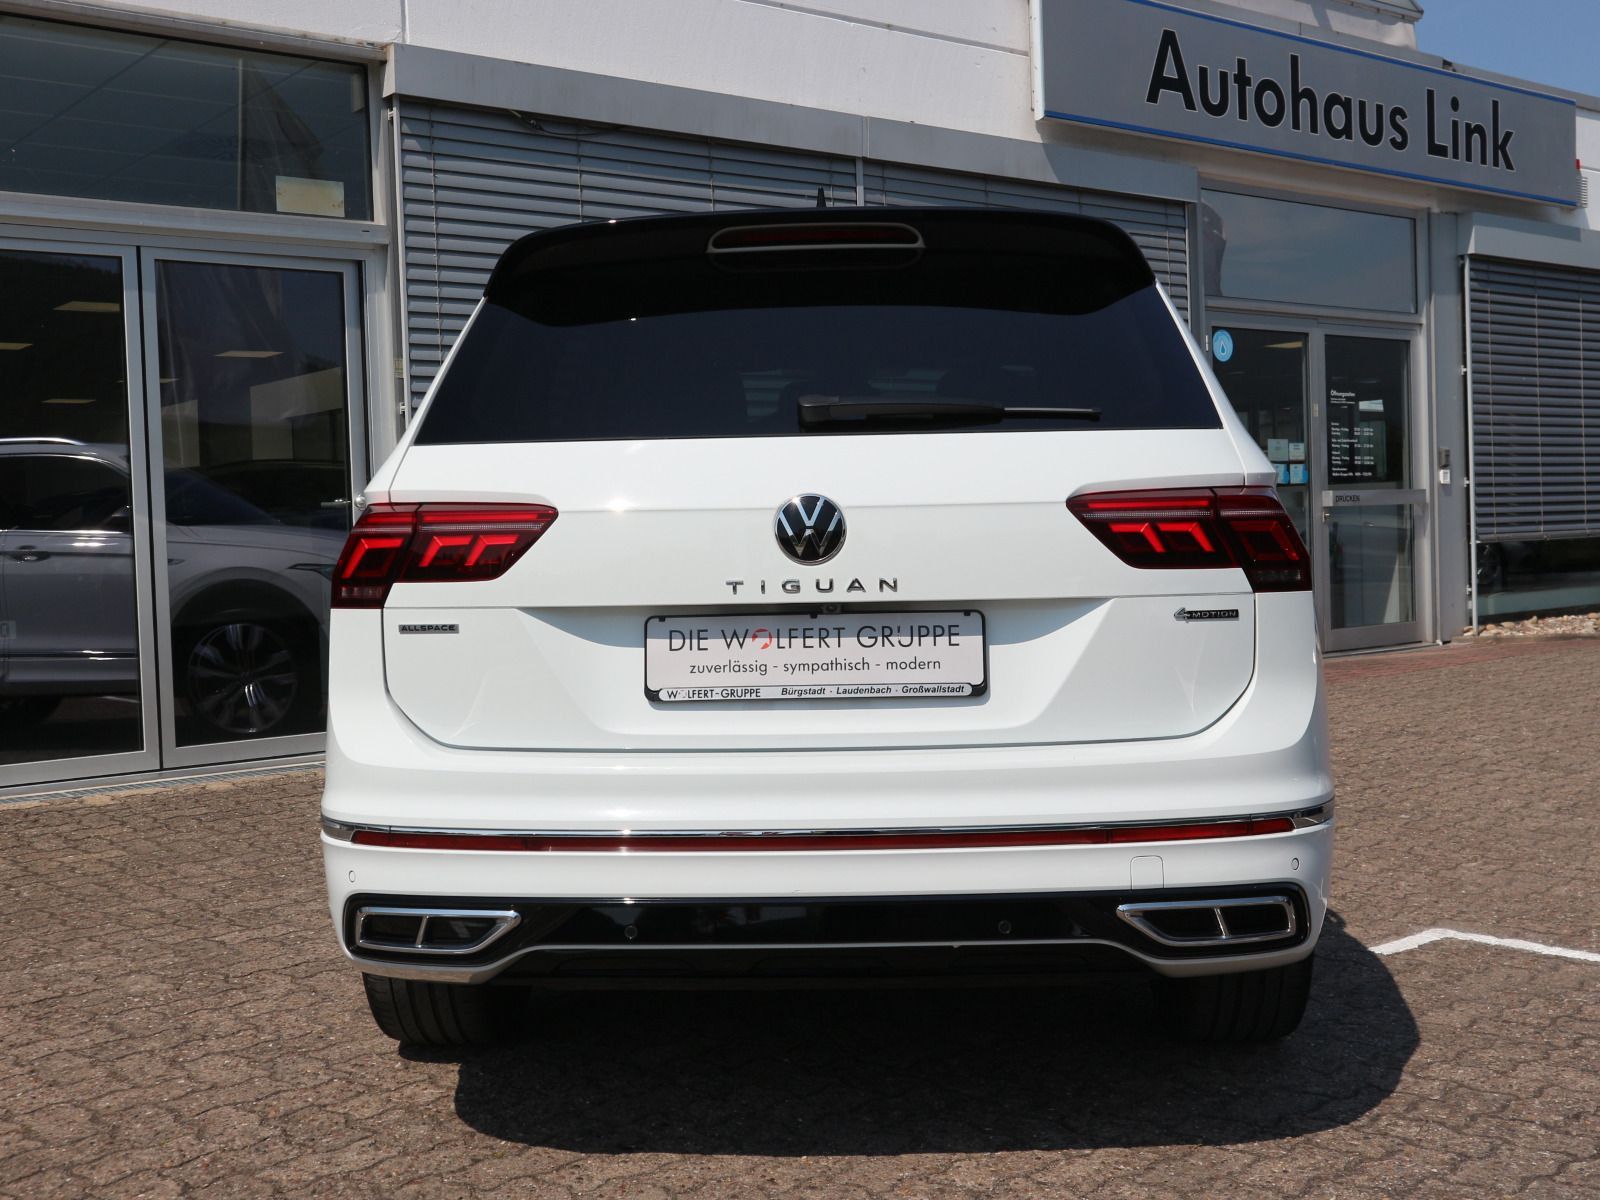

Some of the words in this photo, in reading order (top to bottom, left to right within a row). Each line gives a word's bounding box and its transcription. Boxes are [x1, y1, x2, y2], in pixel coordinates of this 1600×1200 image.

[1145, 28, 1409, 152] Autohaus
[1426, 87, 1517, 173] Link
[726, 578, 898, 595] TIGUAN
[401, 624, 456, 632] ALLSPACE
[669, 629, 709, 651] DIE
[857, 625, 960, 648] GRUPPE
[689, 659, 768, 676] zuverlässig
[783, 656, 870, 675] sympathisch
[886, 656, 941, 670] modern
[781, 687, 826, 697] Bürgstadt
[836, 686, 892, 696] Laudenbach
[901, 684, 965, 695] Großwallstadt
